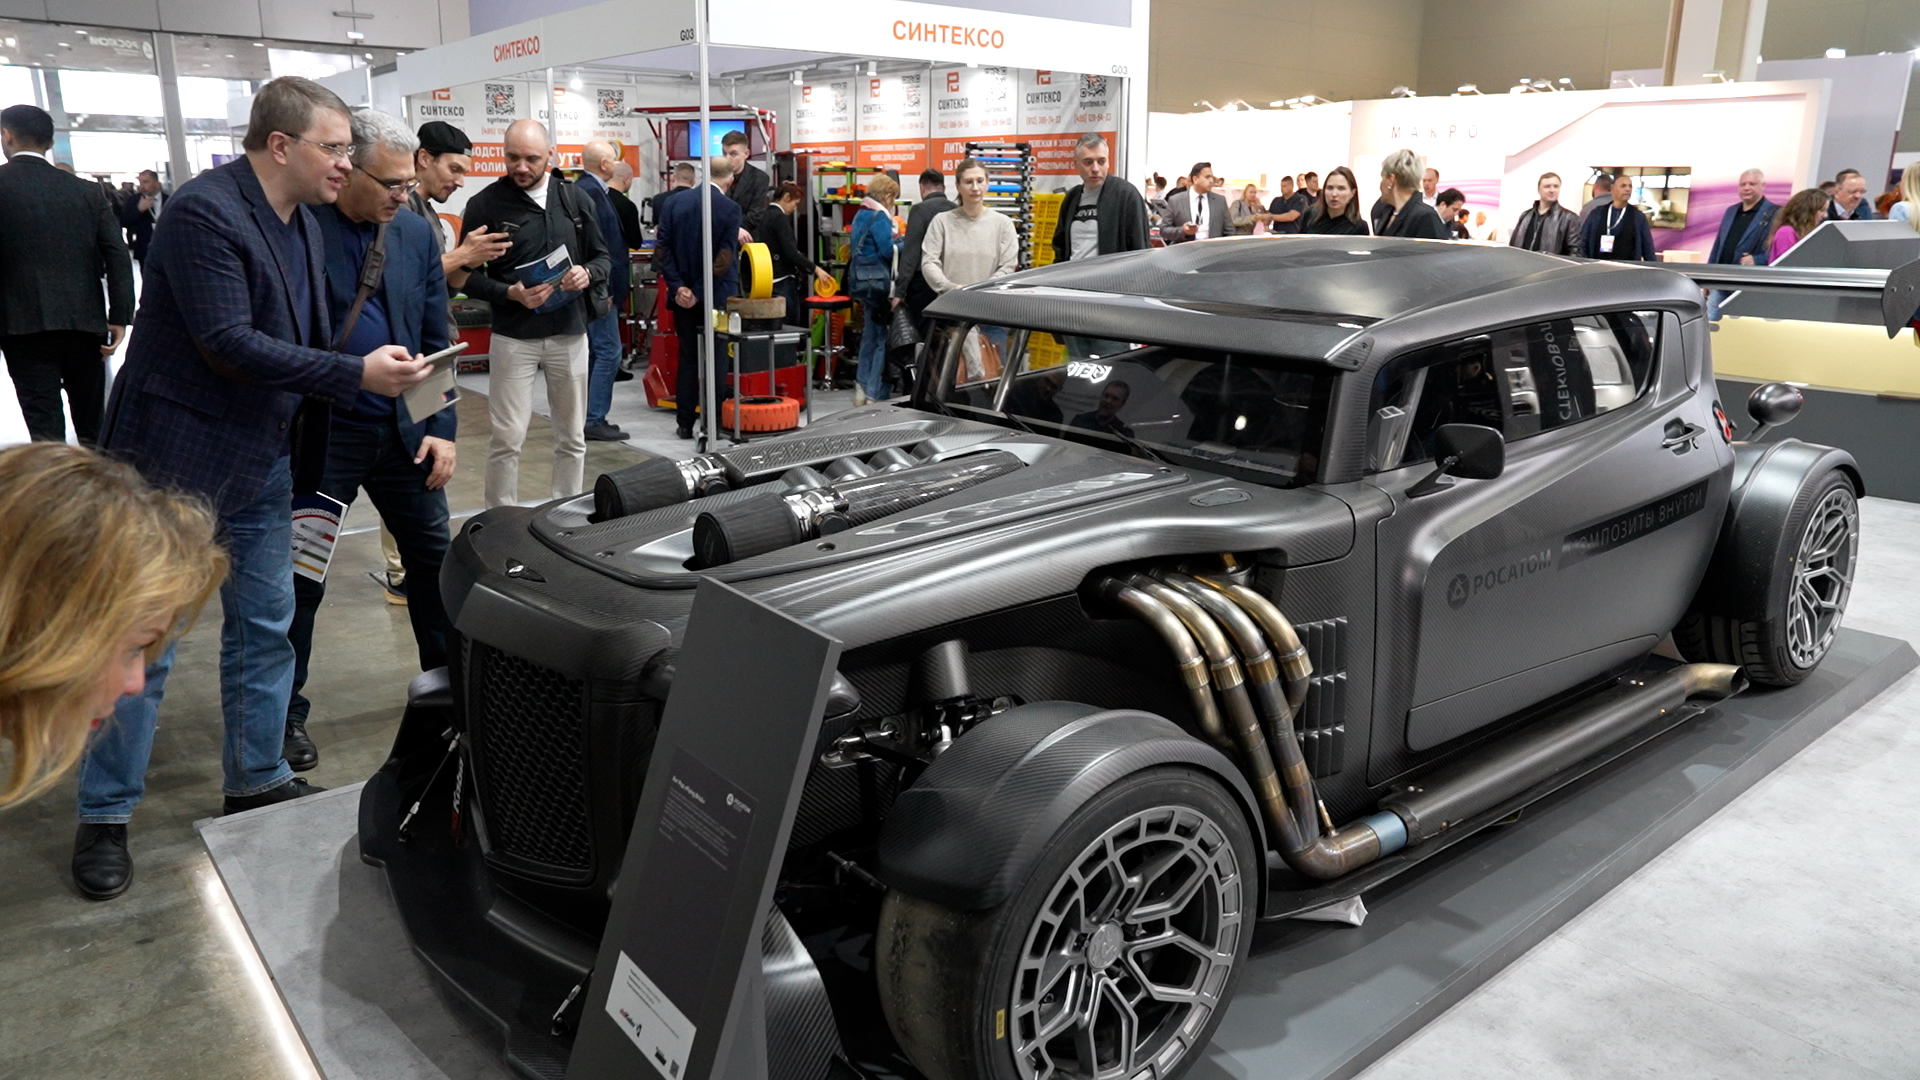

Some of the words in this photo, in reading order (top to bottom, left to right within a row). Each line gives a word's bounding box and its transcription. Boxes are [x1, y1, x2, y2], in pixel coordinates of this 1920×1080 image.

[680, 28, 695, 41] G03
[893, 20, 1005, 49] СИНТЕКСО
[493, 36, 540, 63] СИНТЕКСО
[1112, 65, 1128, 75] G03
[1473, 549, 1552, 596] РОСАТОМ
[1568, 511, 1655, 553] ОМПОЗИТЫ
[1658, 488, 1702, 523] ВНУТРИ
